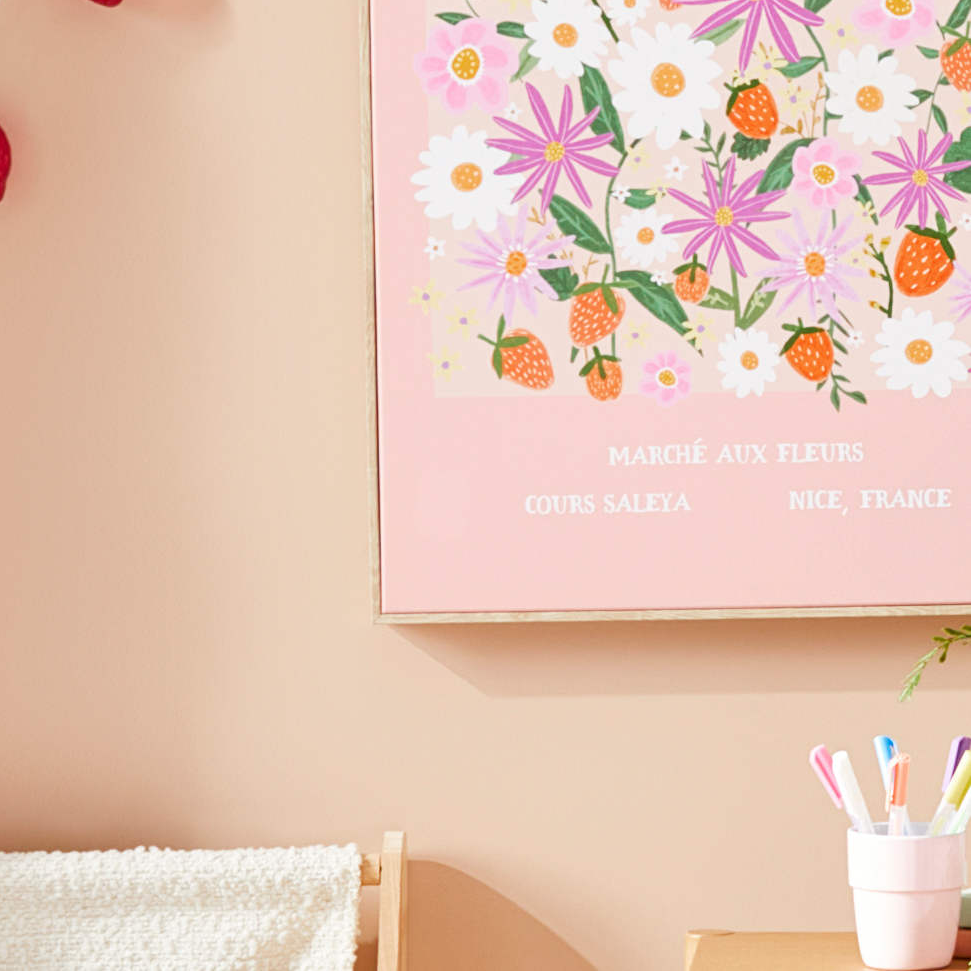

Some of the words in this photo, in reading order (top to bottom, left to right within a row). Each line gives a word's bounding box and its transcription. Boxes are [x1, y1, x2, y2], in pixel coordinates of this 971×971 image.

[608, 438, 707, 466] MARCHÉ
[715, 444, 768, 464] AUX
[776, 442, 864, 464] FLEURS
[524, 493, 596, 515] COURS
[603, 492, 692, 514] SALEYA
[788, 489, 849, 517] NICE,
[859, 488, 952, 510] FRANCE
